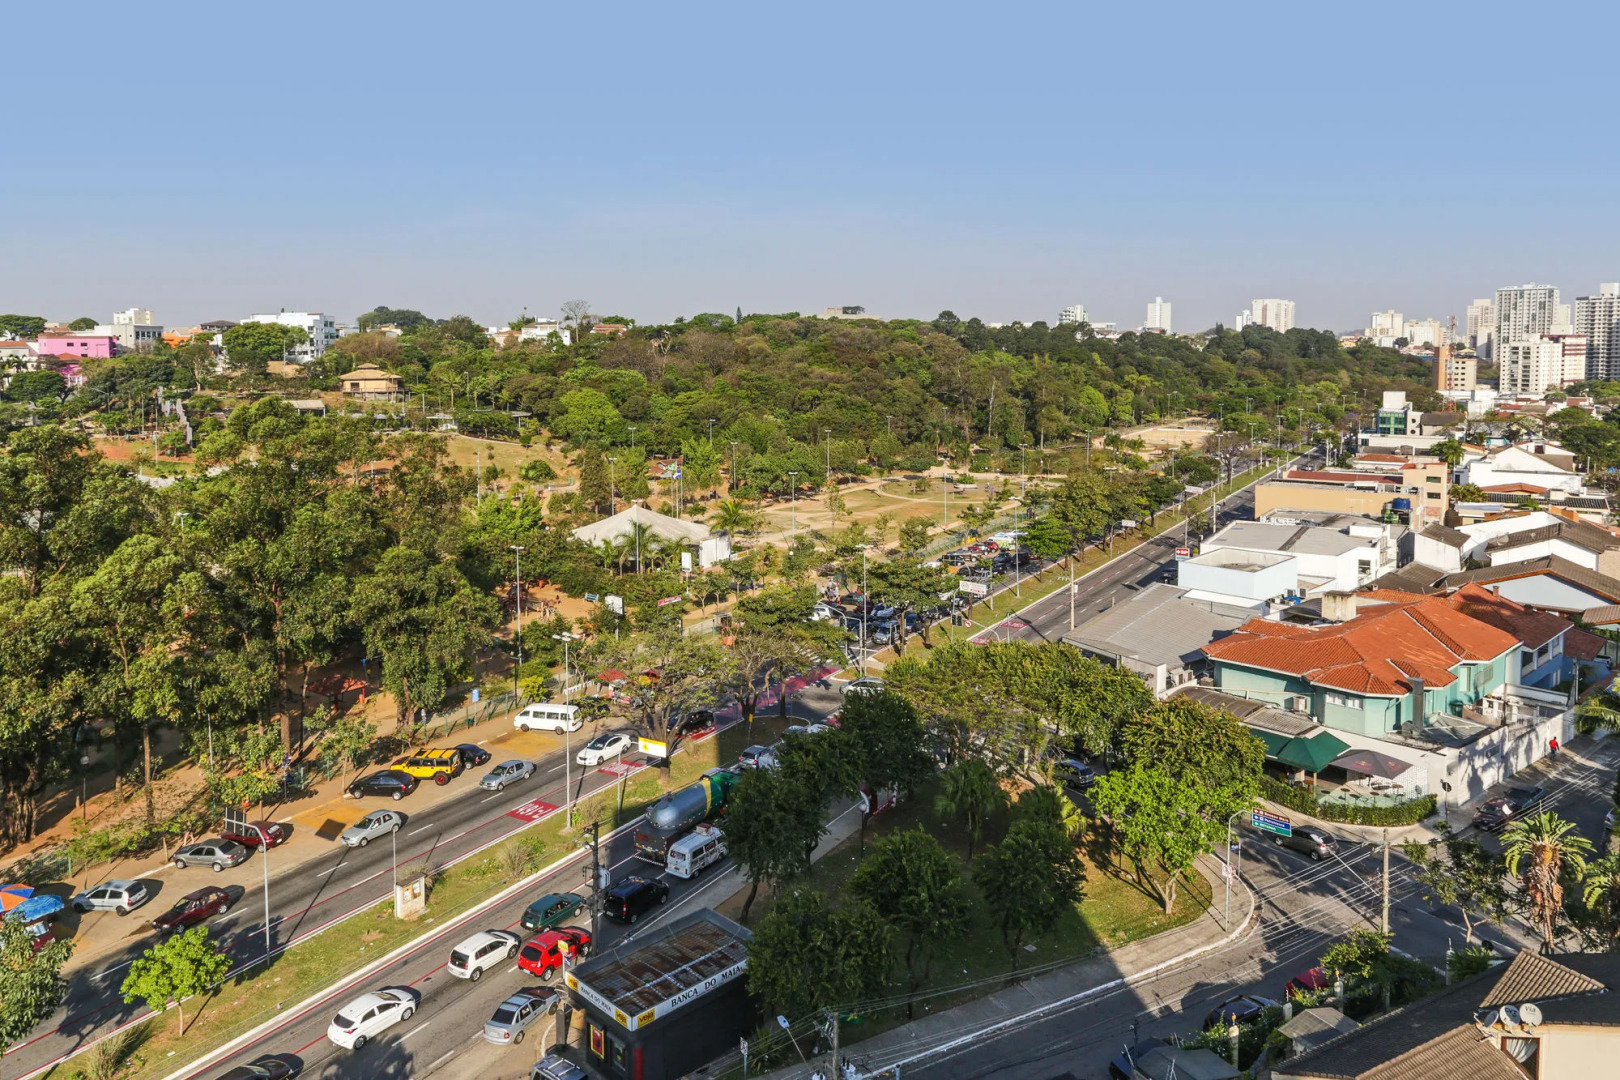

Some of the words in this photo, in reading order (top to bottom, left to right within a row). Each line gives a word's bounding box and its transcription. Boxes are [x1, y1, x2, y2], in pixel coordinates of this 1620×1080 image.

[671, 988, 698, 1008] BANCA
[704, 978, 717, 990] DO
[720, 965, 741, 981] MAIA
[1525, 1005, 1536, 1013] Via
[639, 1011, 654, 1023] veja
